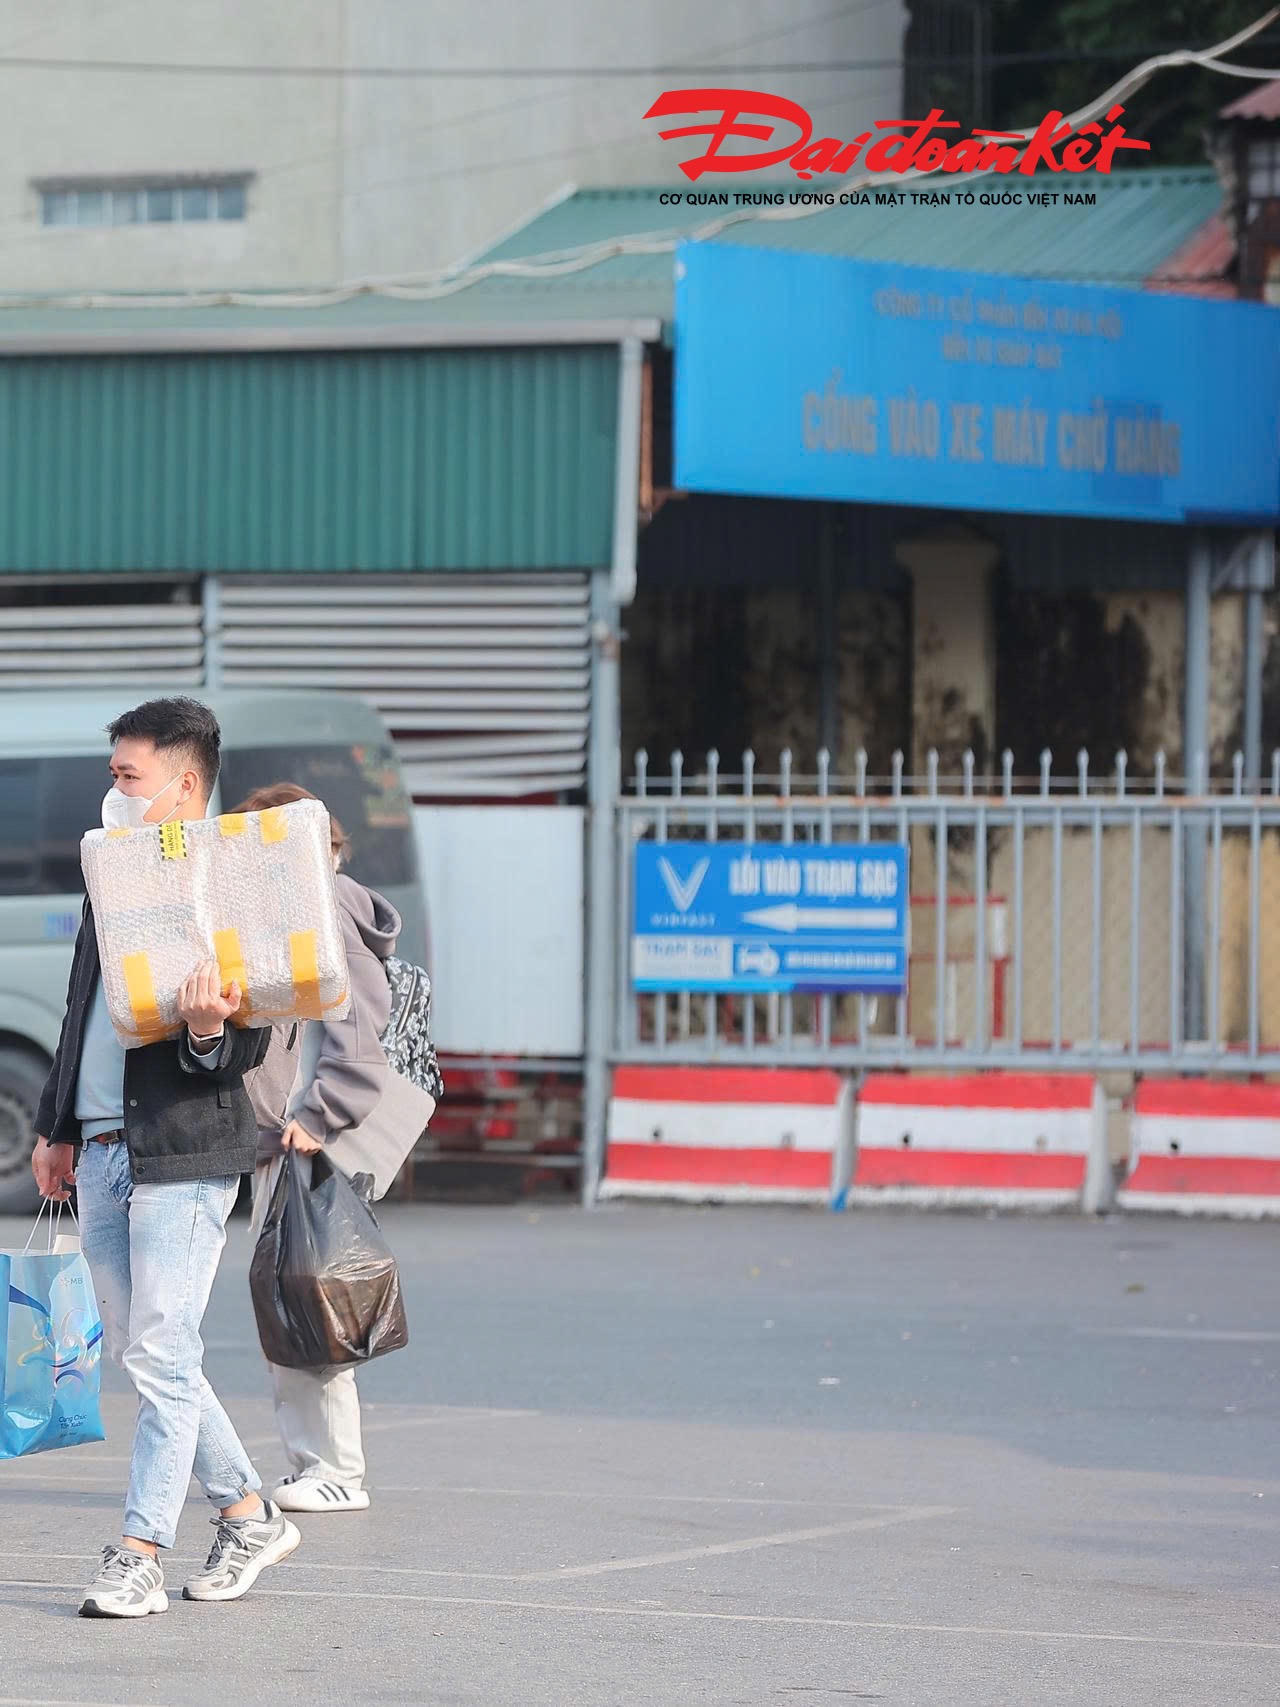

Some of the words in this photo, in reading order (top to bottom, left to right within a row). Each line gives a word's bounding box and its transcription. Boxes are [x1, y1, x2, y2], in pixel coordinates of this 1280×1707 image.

[802, 366, 877, 454] CỔNG
[888, 385, 940, 458] VÀO
[949, 402, 984, 462] XE
[993, 396, 1048, 467] MÁY
[1114, 403, 1182, 477] HÀNG
[729, 850, 761, 897] LỐI
[763, 853, 802, 897] VÀO
[805, 859, 857, 902] TRẠM
[860, 859, 898, 902] SẠC
